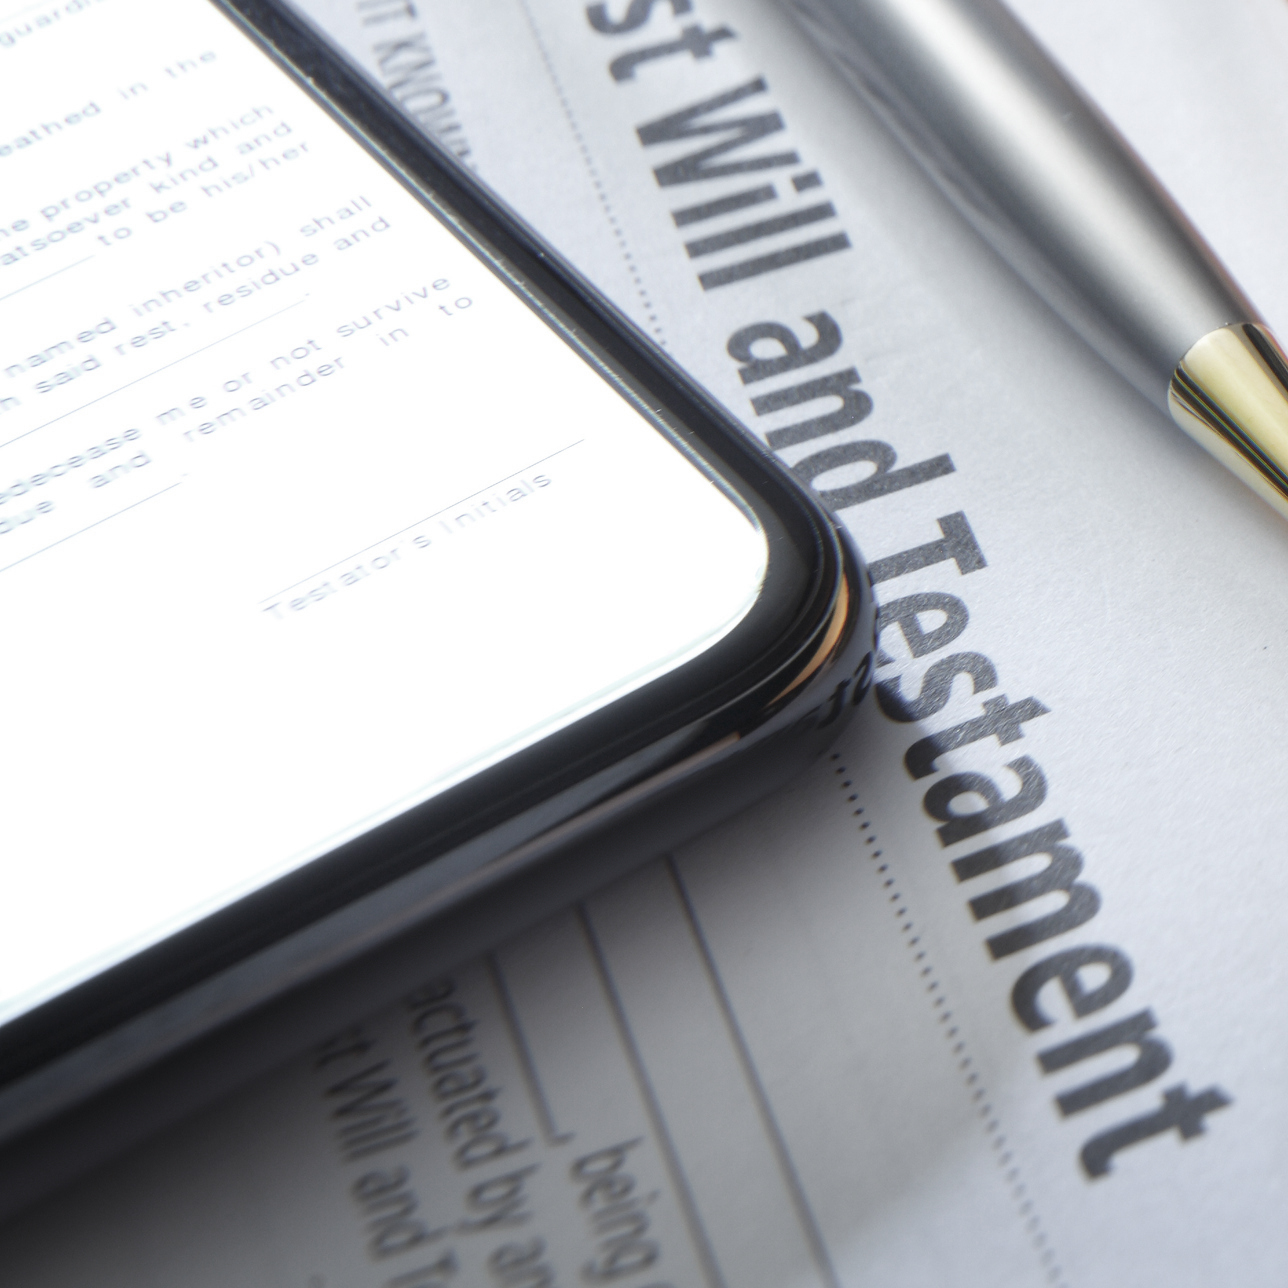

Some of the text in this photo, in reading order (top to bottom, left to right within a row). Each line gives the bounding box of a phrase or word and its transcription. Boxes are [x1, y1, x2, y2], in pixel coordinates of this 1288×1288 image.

[38, 149, 173, 224] property
[184, 101, 276, 152] which
[95, 138, 312, 247] to be his/her
[149, 154, 220, 196] kind
[235, 119, 294, 156] and
[636, 76, 853, 292] Will
[2, 194, 374, 379] named inheritor) shall
[32, 352, 103, 395] said
[200, 250, 320, 314] residue
[332, 214, 392, 253] and
[154, 393, 208, 426] me
[221, 369, 256, 395] or
[268, 336, 324, 371] not
[335, 274, 452, 339] survive
[87, 450, 153, 489] and
[182, 352, 346, 443] remainder
[375, 325, 410, 347] in
[436, 293, 475, 318] to
[726, 309, 957, 510] and
[868, 510, 1234, 1181] Testament
[323, 1059, 419, 1163] Will
[351, 1164, 449, 1261] and
[455, 1162, 540, 1236] by
